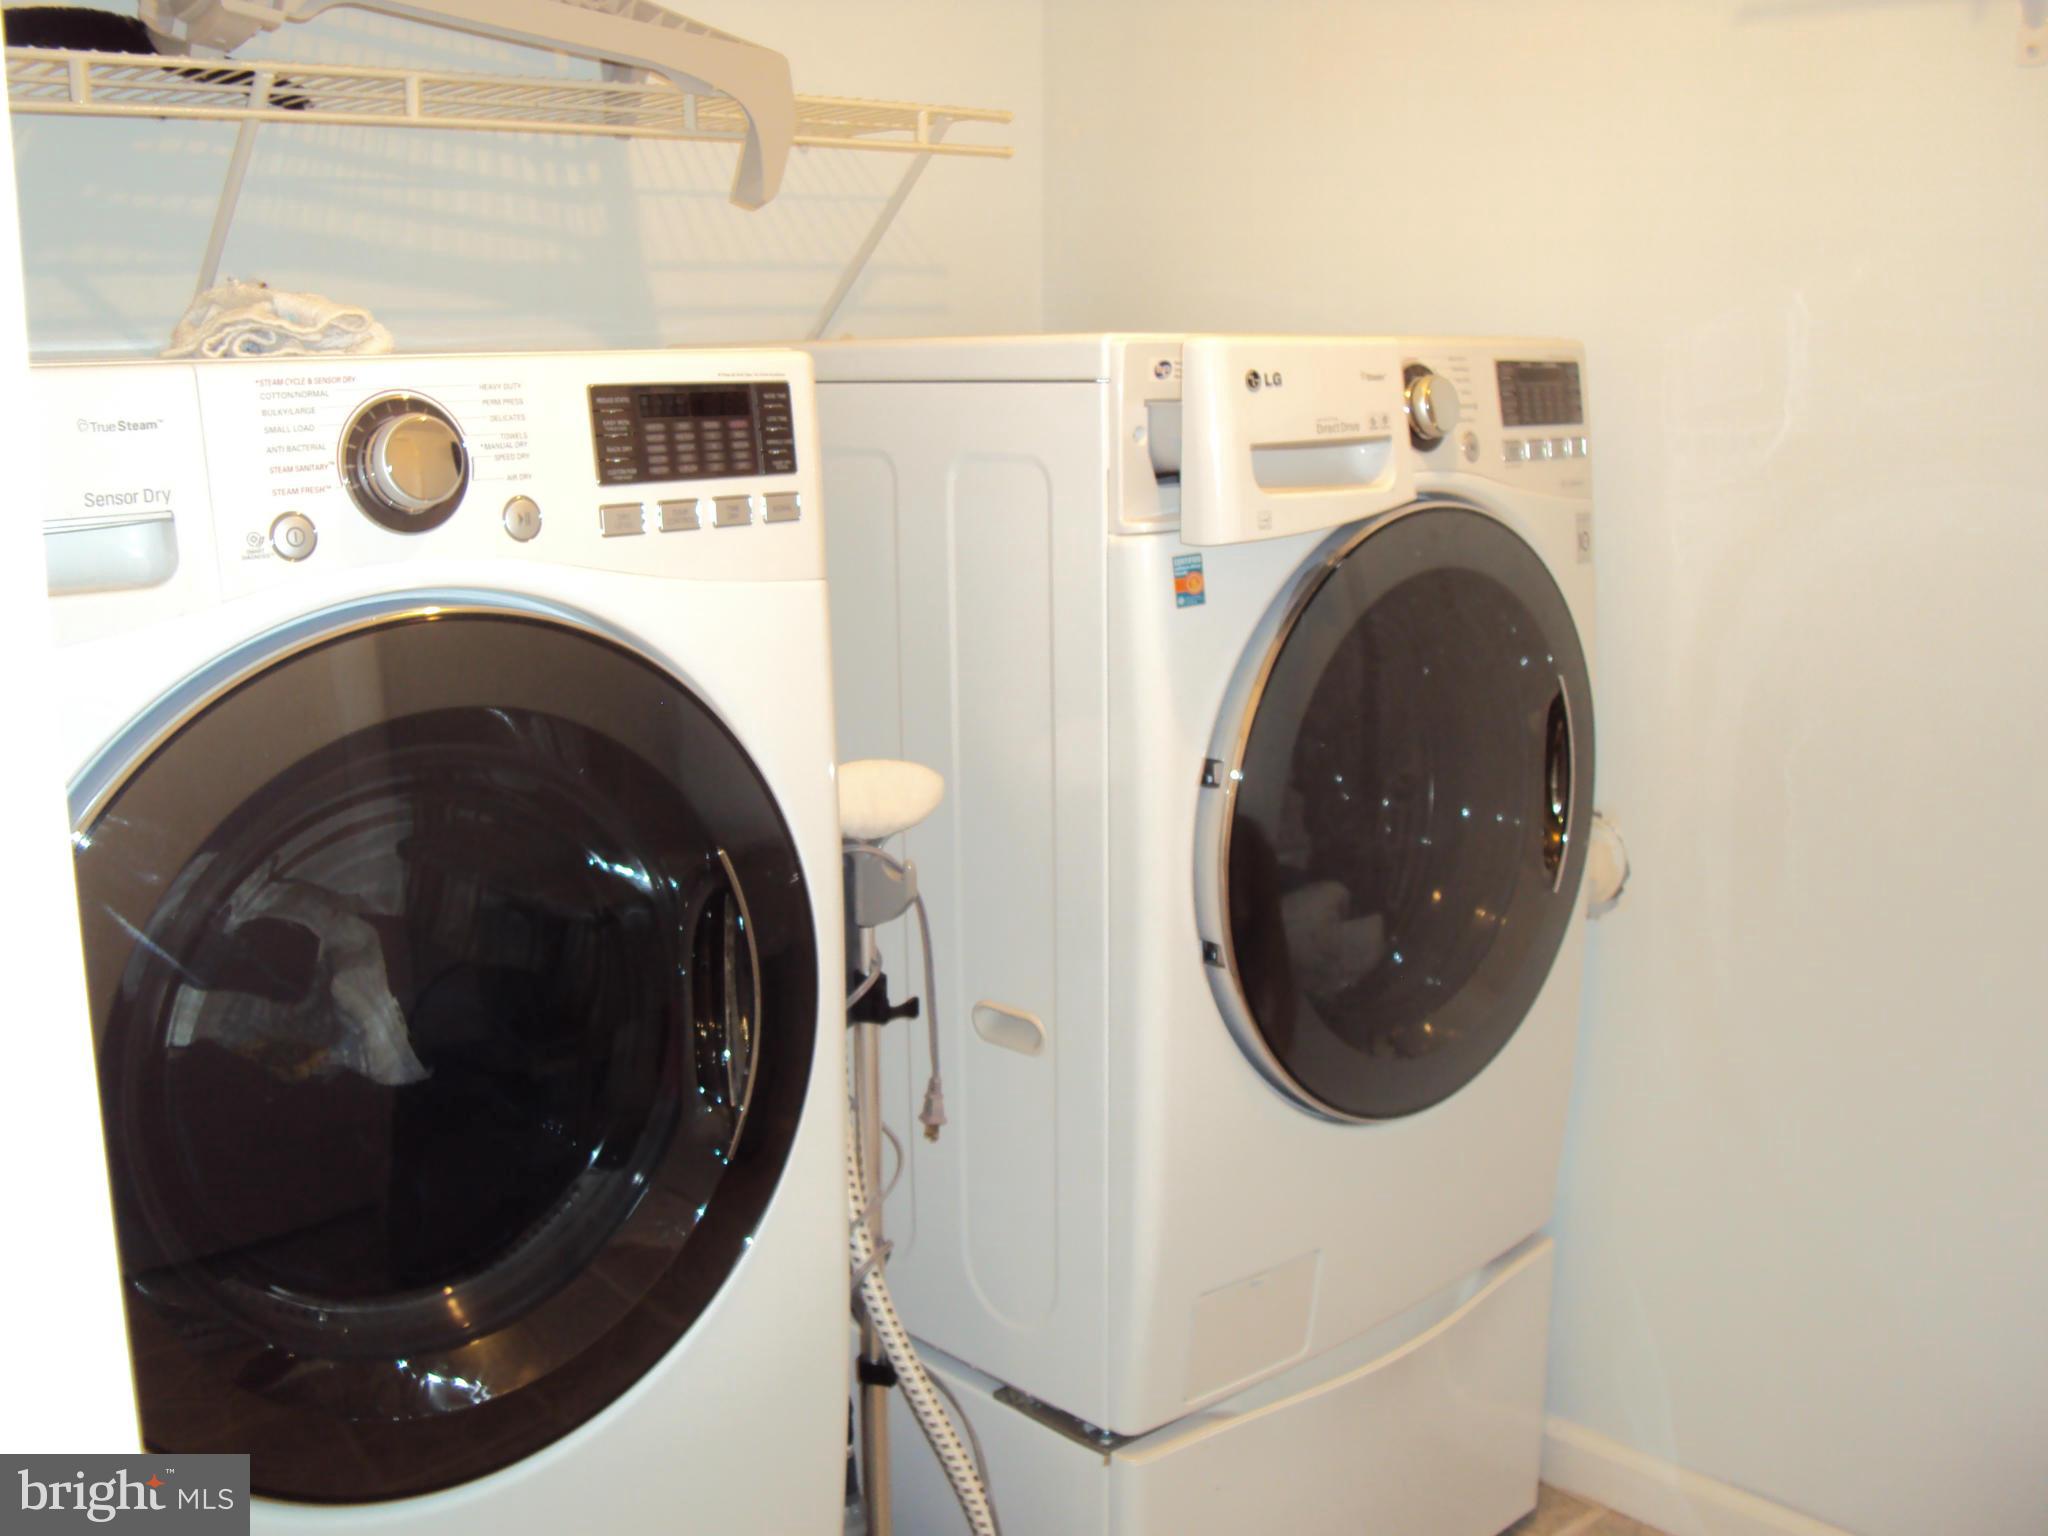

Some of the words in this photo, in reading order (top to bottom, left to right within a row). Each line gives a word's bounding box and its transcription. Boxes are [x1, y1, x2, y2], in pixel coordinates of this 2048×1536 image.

[1264, 371, 1283, 388] LG
[264, 425, 291, 435] SMALL
[293, 424, 316, 433] LOAD
[84, 492, 138, 508] Sensor
[143, 488, 171, 505] Dry
